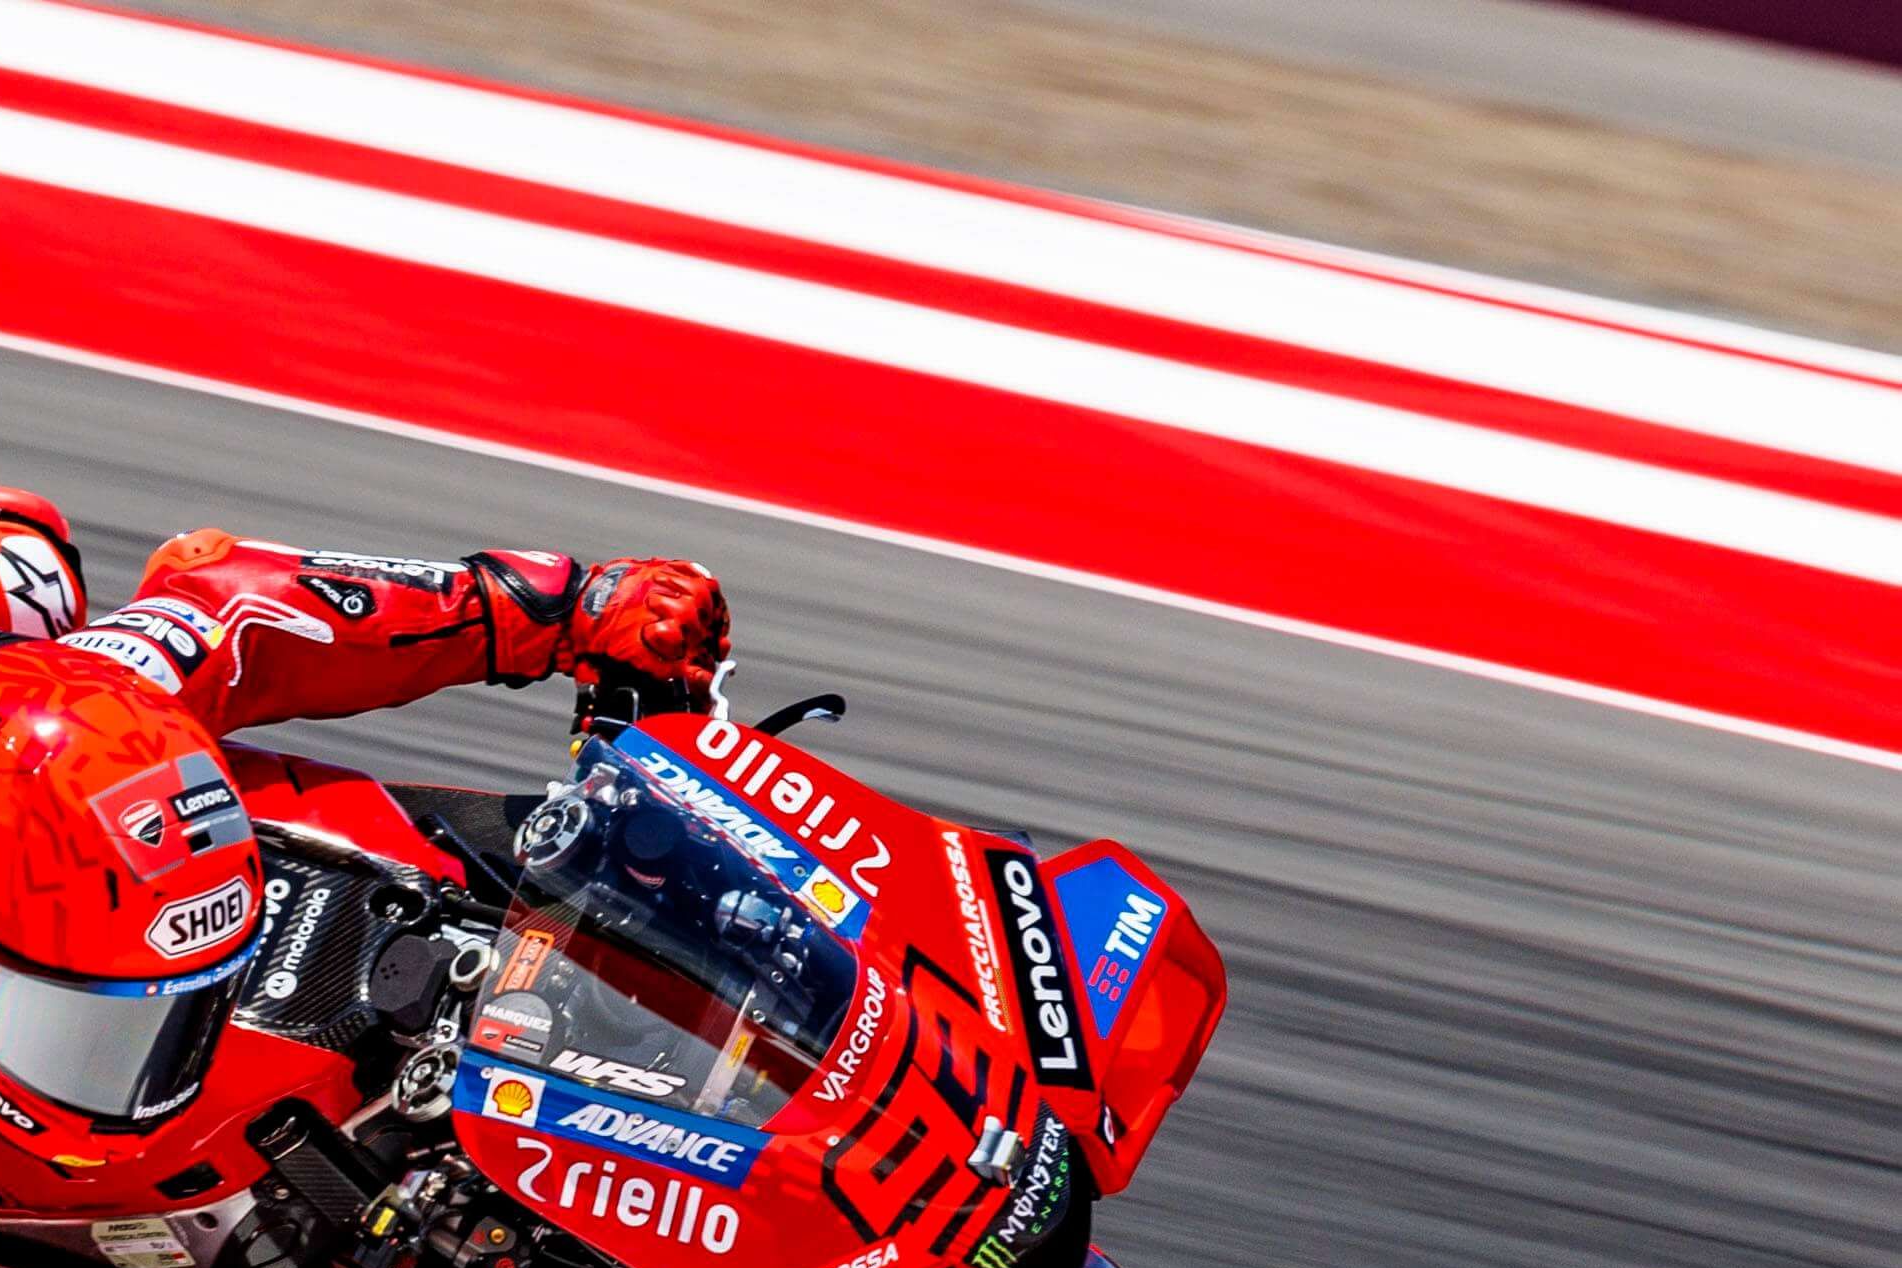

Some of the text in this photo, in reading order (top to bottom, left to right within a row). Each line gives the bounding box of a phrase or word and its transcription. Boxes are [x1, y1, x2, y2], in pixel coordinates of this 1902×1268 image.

[640, 751, 799, 860] ADVANCE
[283, 888, 332, 970] motorola
[942, 831, 1007, 1032] FRECCIAROSSA
[1004, 860, 1078, 1070] Lenovo
[1105, 894, 1163, 961] TIM
[161, 974, 212, 996] Estrella
[482, 1004, 552, 1033] MARQUEZ
[549, 1050, 687, 1097] WRS
[814, 966, 889, 1102] VARGROUP
[557, 1103, 745, 1173] ADVANCE
[821, 943, 1027, 1256] 93
